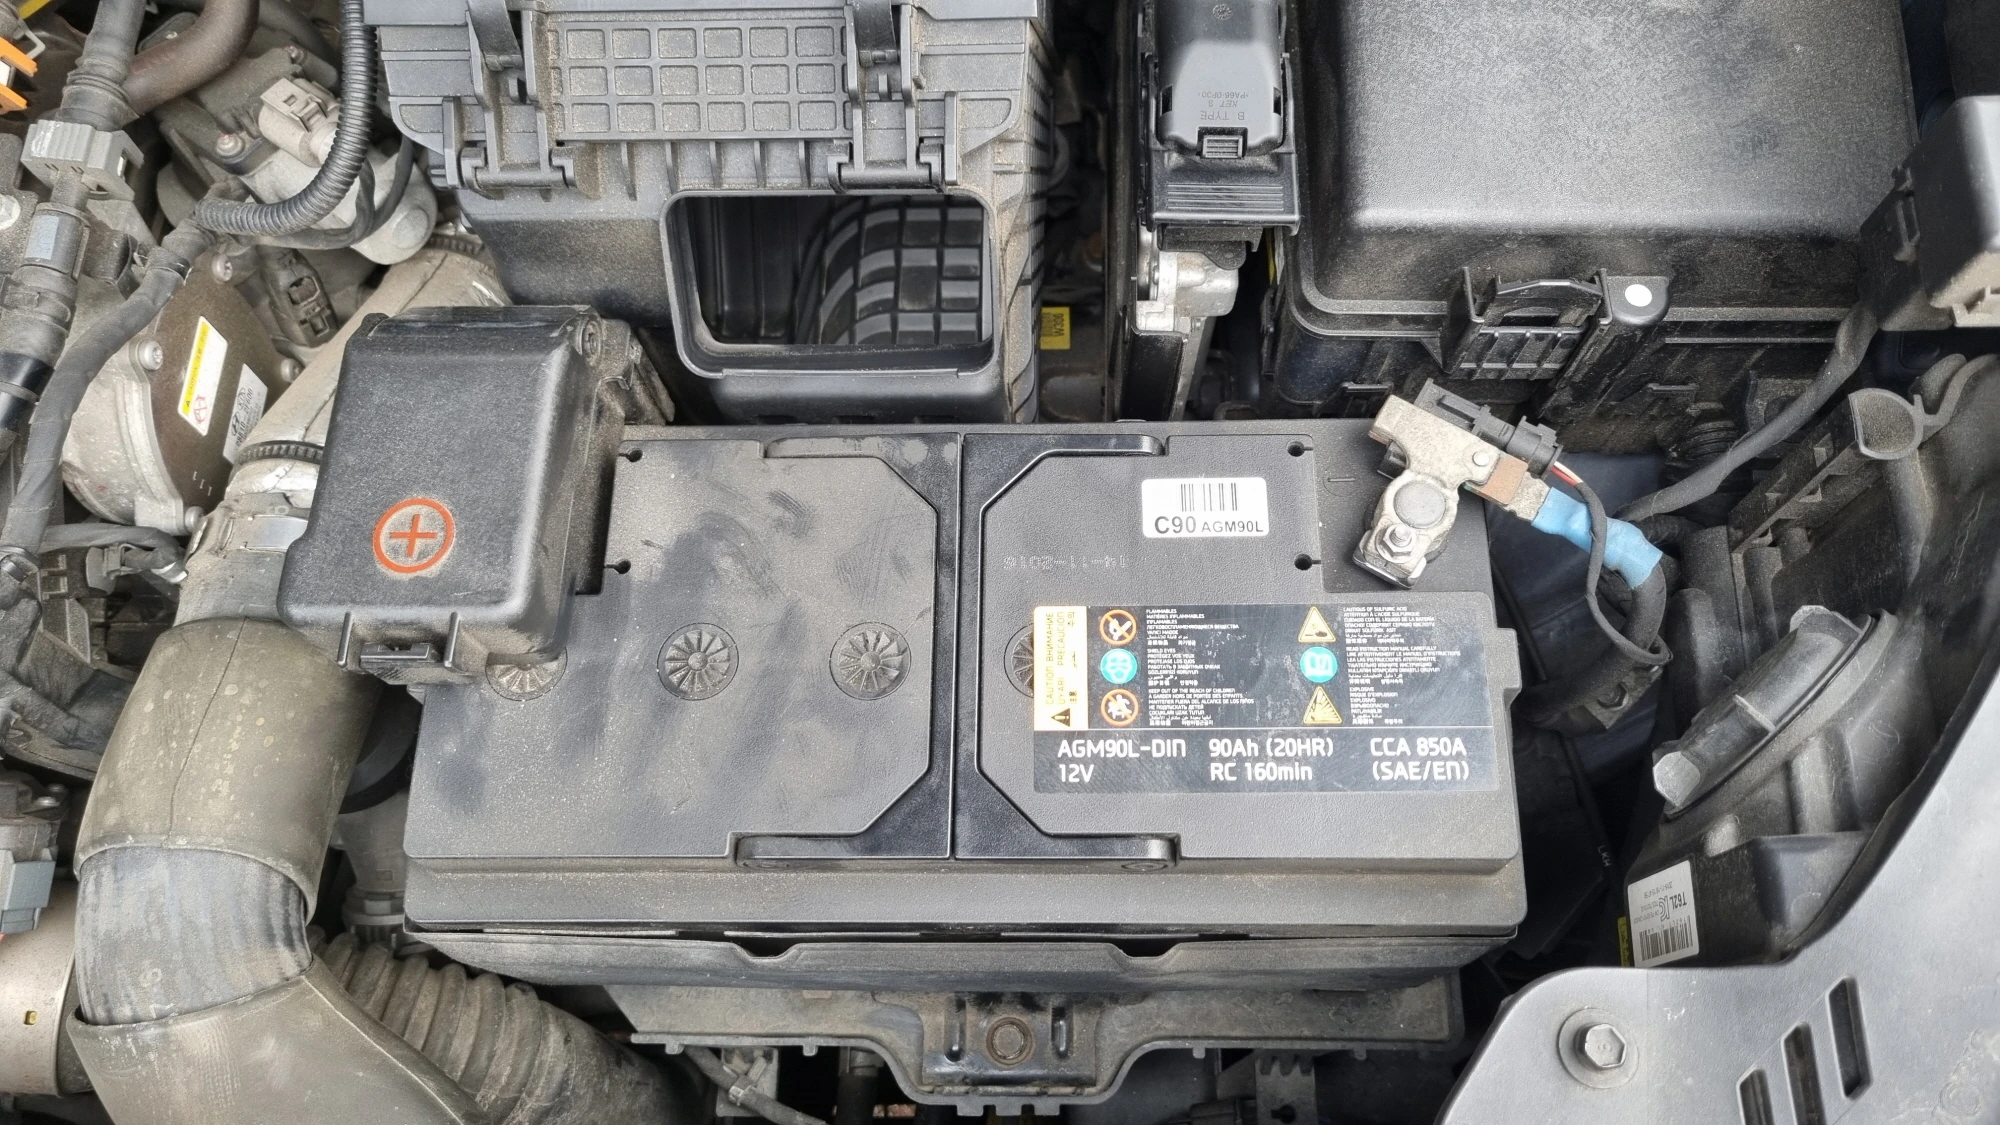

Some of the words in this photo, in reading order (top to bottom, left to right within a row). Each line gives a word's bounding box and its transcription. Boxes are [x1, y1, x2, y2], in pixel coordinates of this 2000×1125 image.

[1200, 110, 1230, 121] TYPE
[1237, 111, 1245, 121] B
[1154, 516, 1197, 534] C90
[1201, 520, 1264, 533] AGM90L
[1045, 613, 1054, 662] ВНИМАНИЕ
[1045, 665, 1054, 705] CAUTION
[1057, 677, 1066, 705] UYARI
[1209, 738, 1259, 757] 90Ah
[1265, 737, 1334, 758] (20HR)
[1370, 737, 1410, 756] CCA
[1416, 737, 1467, 756] 850A
[1059, 763, 1094, 782] 12V
[1210, 762, 1237, 781] RC
[1245, 761, 1312, 781] 160min
[1373, 760, 1469, 781] (SAE/EN)
[1669, 891, 1687, 911] T62L
